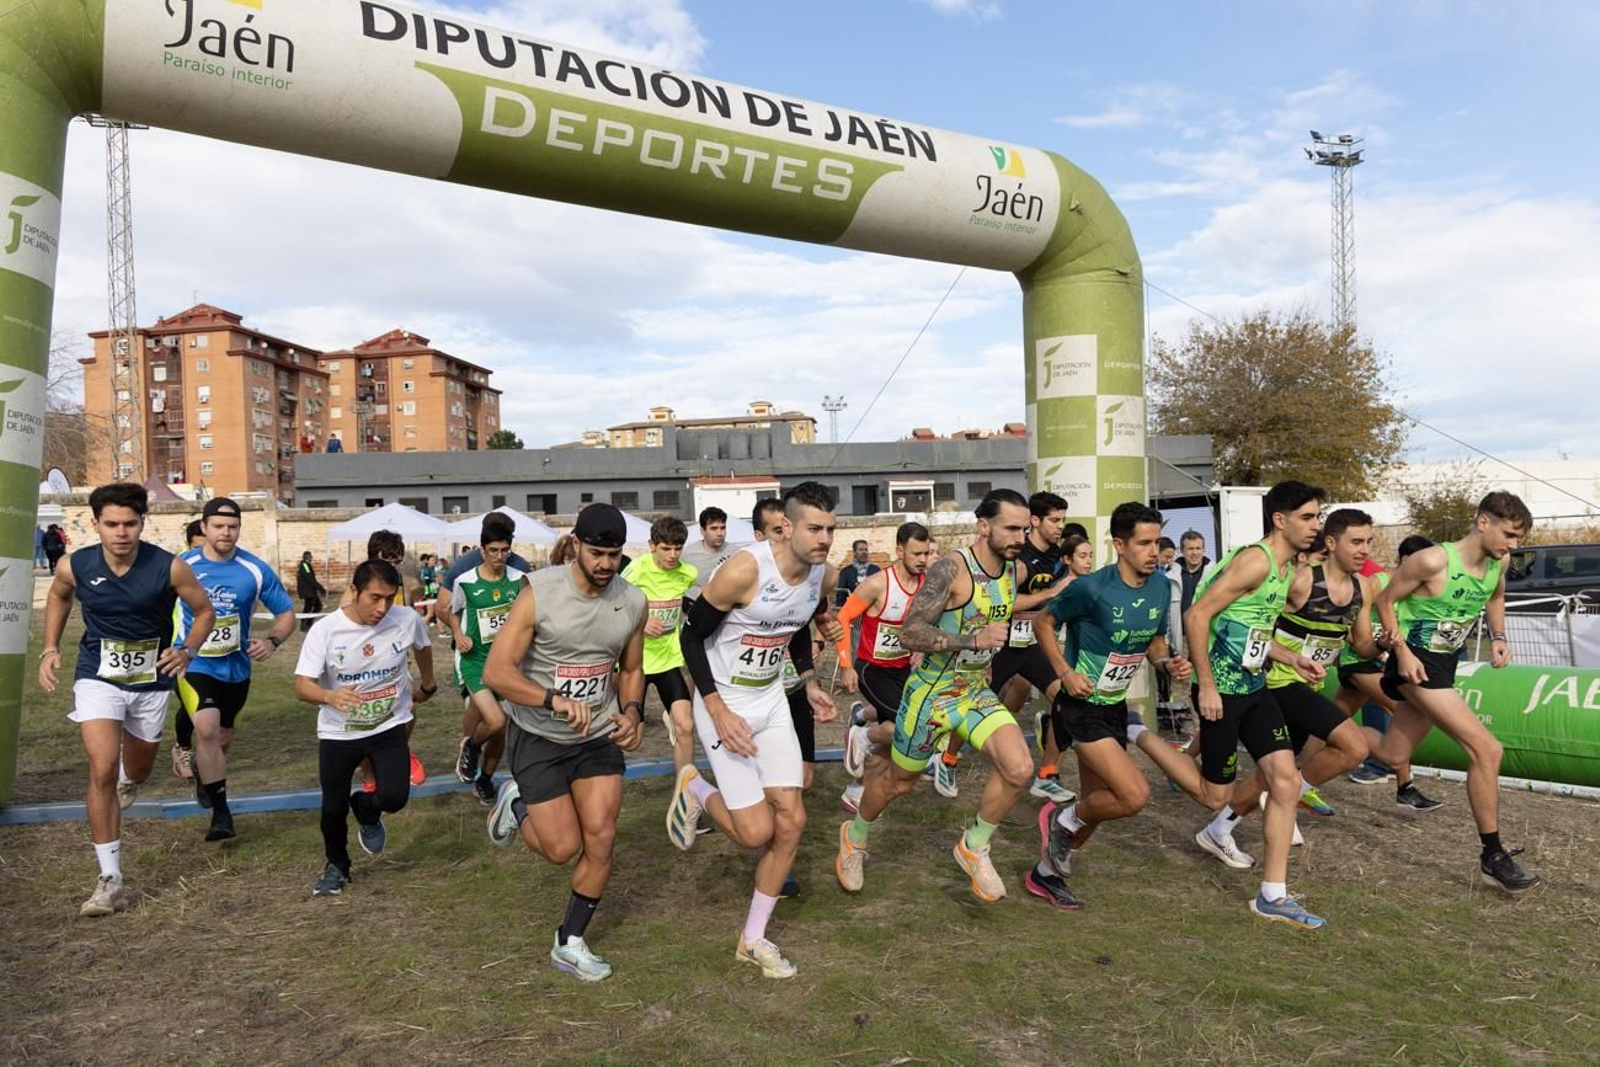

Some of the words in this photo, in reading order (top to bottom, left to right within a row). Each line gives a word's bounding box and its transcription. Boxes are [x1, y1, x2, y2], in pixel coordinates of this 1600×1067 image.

[164, 0, 294, 73] Jaén
[231, 66, 294, 90] interior
[359, 1, 731, 119] DIPUTACIÓN
[744, 91, 813, 137] DE
[824, 110, 937, 162] JAÉN
[480, 85, 855, 202] DEPORTES
[973, 174, 1043, 222] Jaén
[7, 420, 19, 432] DE
[490, 614, 506, 629] 55
[211, 627, 231, 642] 28
[881, 634, 900, 647] 22
[1249, 640, 1266, 659] 51
[1311, 648, 1332, 662] 85
[109, 651, 146, 670] 395
[559, 675, 608, 699] 4221
